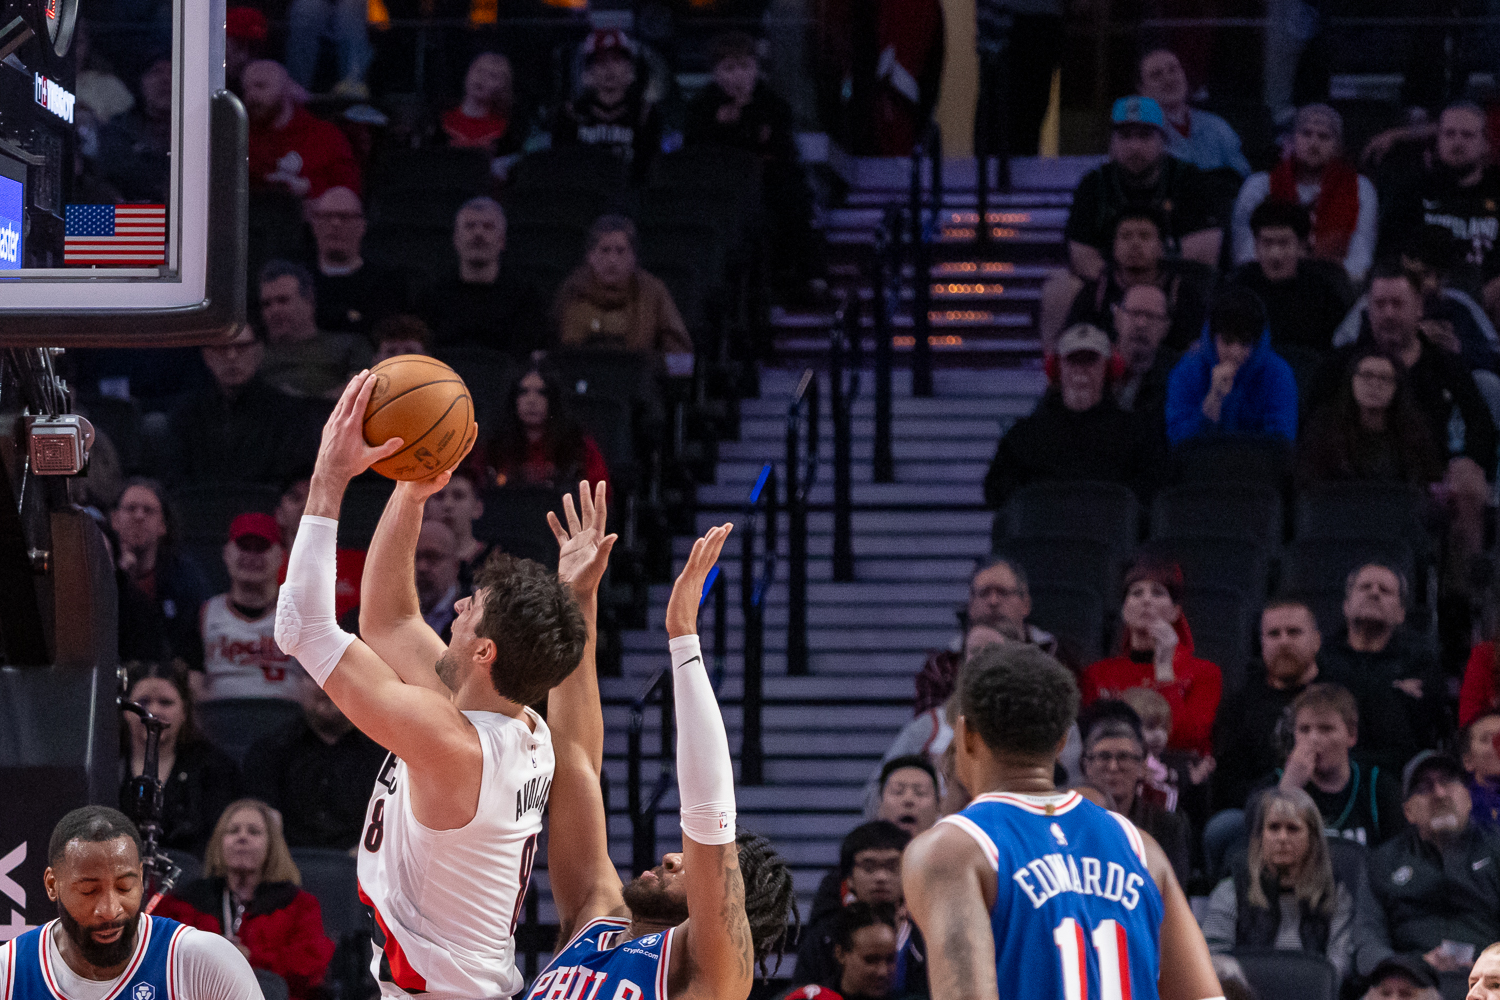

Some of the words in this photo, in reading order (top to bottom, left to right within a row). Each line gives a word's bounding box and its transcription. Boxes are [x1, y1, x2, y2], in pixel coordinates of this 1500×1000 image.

[363, 798, 386, 854] 8
[1012, 852, 1145, 911] EDWARDS
[622, 945, 660, 961] crypto.com
